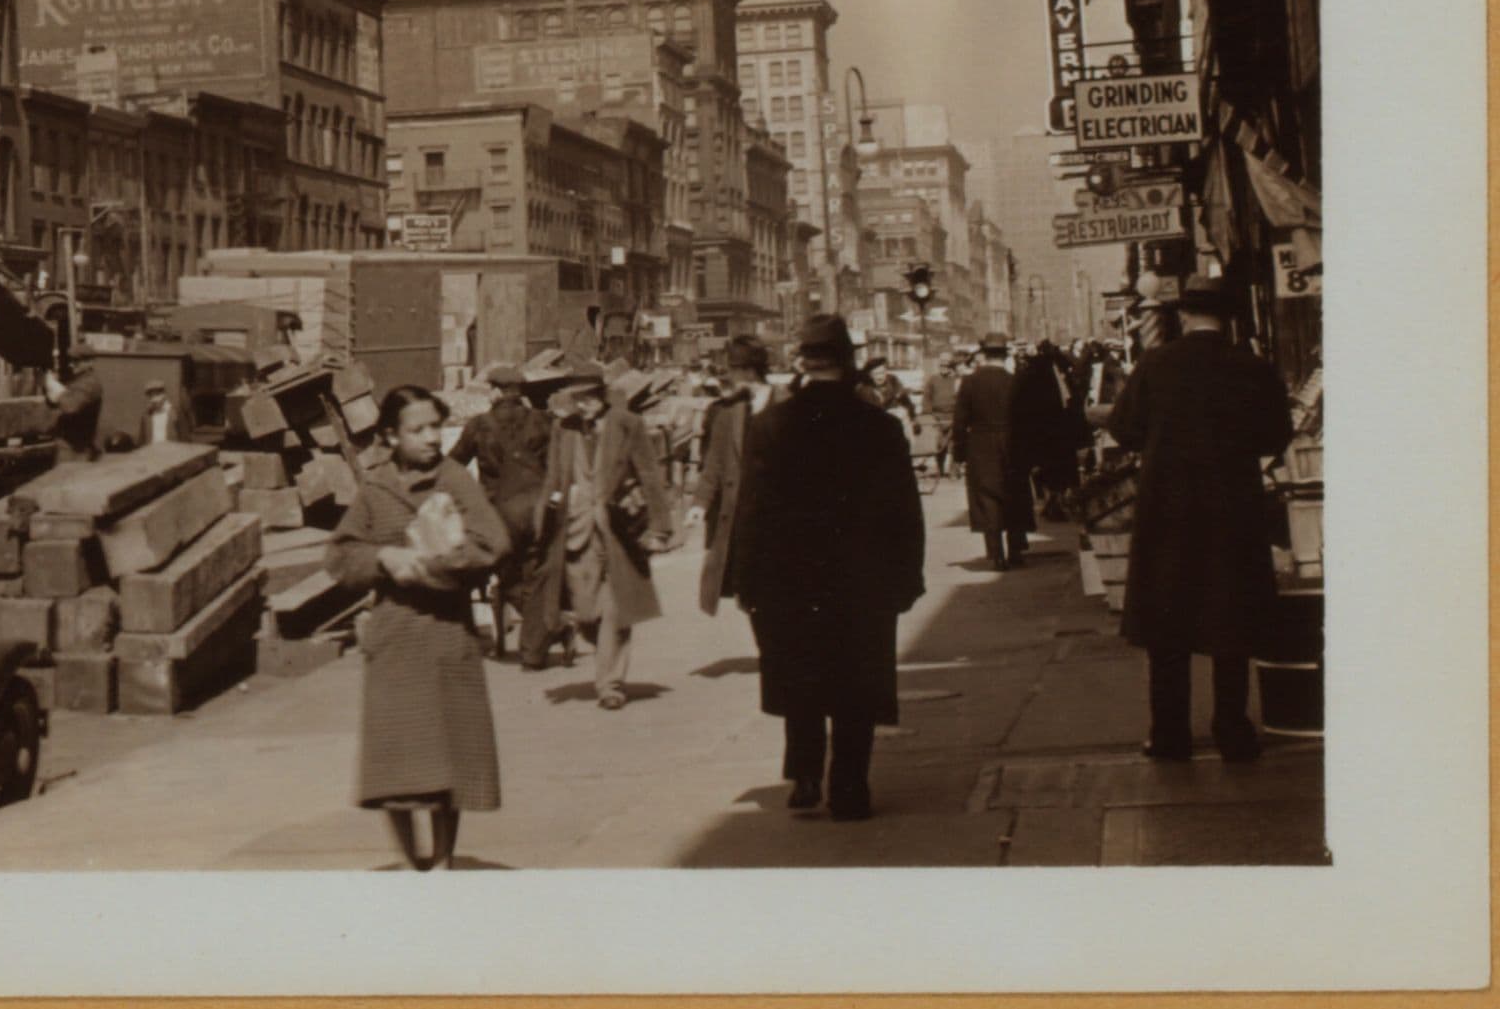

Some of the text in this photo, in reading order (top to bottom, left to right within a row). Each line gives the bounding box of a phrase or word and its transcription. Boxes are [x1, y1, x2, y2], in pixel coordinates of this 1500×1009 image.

[18, 47, 77, 67] JAMES
[1087, 80, 1189, 109] GRINDING
[1082, 112, 1199, 142] ELECTRICIAN
[821, 96, 845, 246] SPEARS
